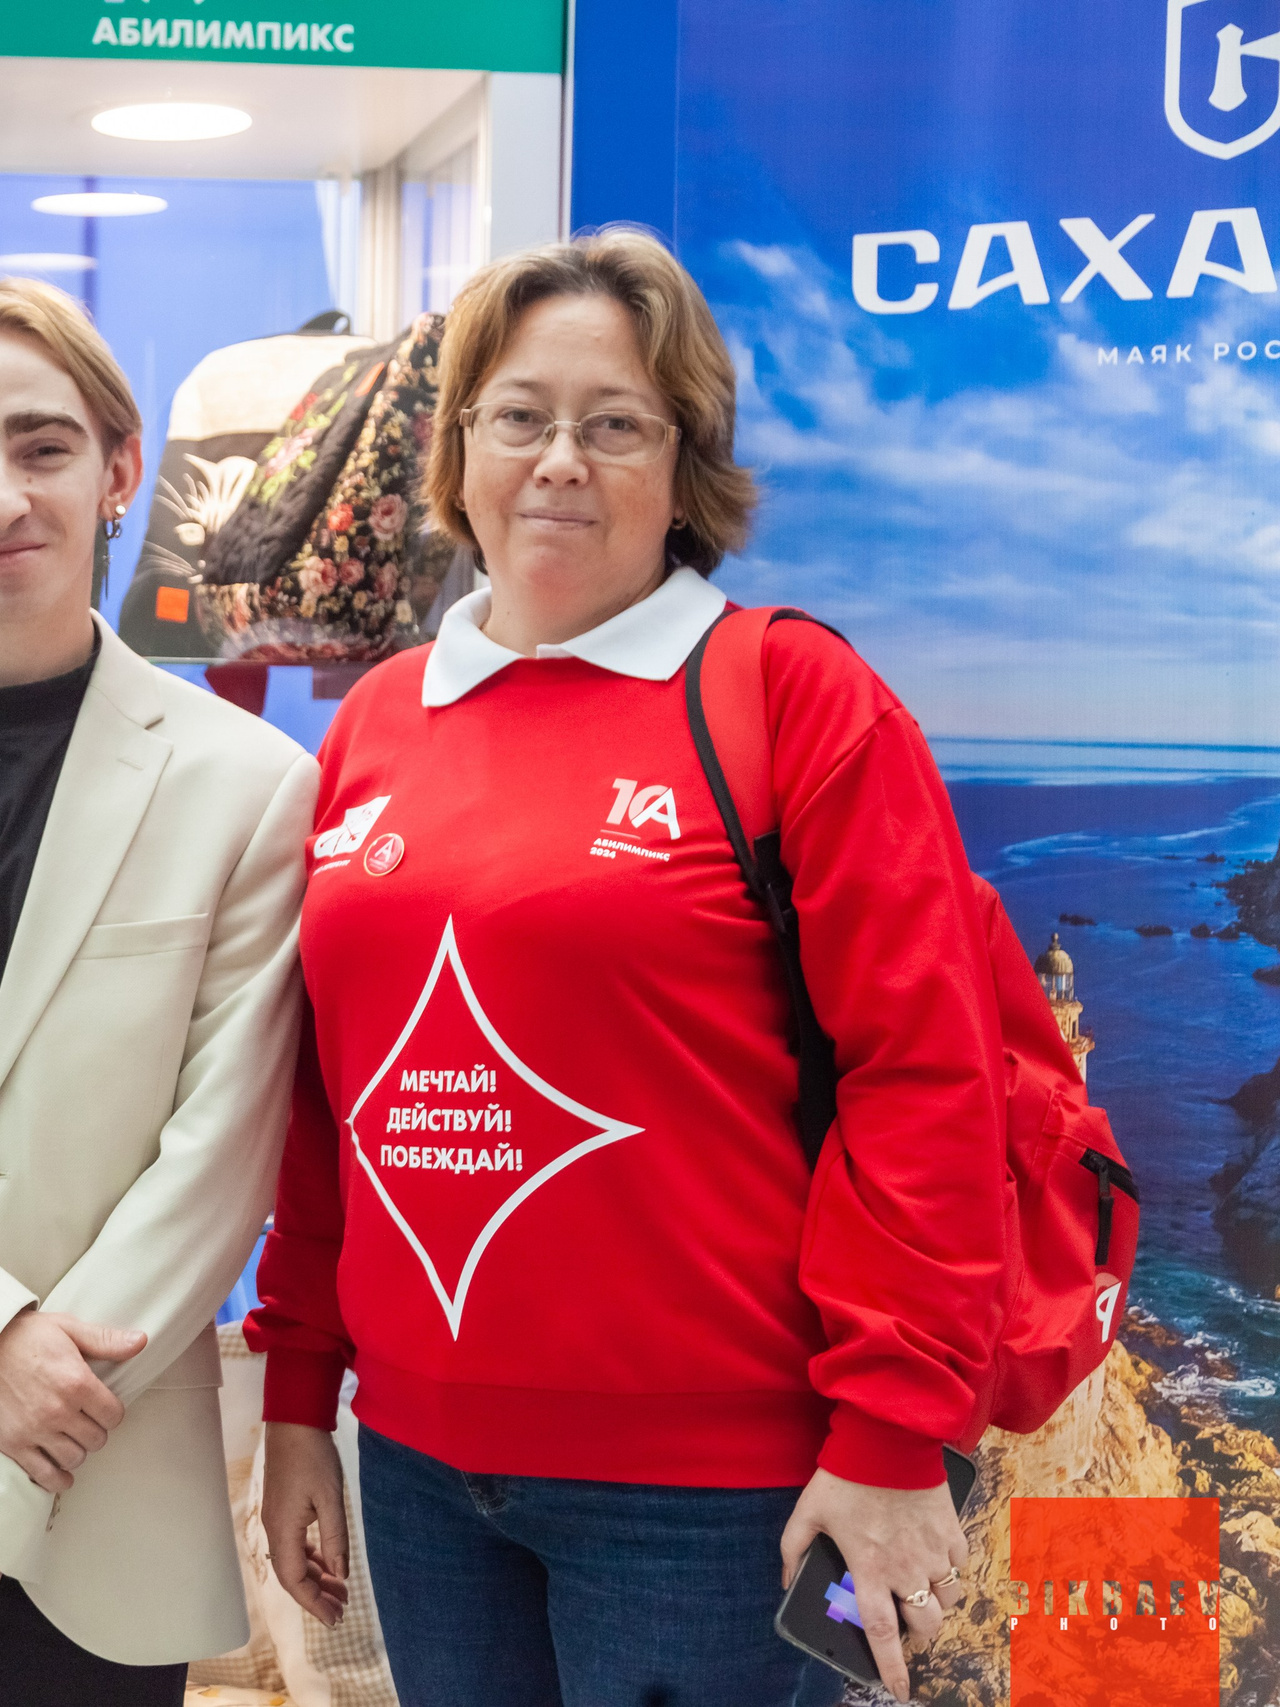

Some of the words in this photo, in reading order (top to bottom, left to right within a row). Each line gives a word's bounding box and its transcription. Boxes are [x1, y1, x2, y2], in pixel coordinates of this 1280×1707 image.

[92, 17, 355, 52] АБИЛИМПИКС
[852, 207, 1278, 314] САХА
[1097, 344, 1192, 366] МАЯК
[589, 846, 617, 859] 2024
[593, 838, 671, 862] АБИЛИМПИКС
[399, 1063, 497, 1093] МЕЧТАЙ!
[386, 1102, 512, 1133] ДЕЙСТВУЙ!
[380, 1142, 523, 1175] ПОБЕЖДАЙ!
